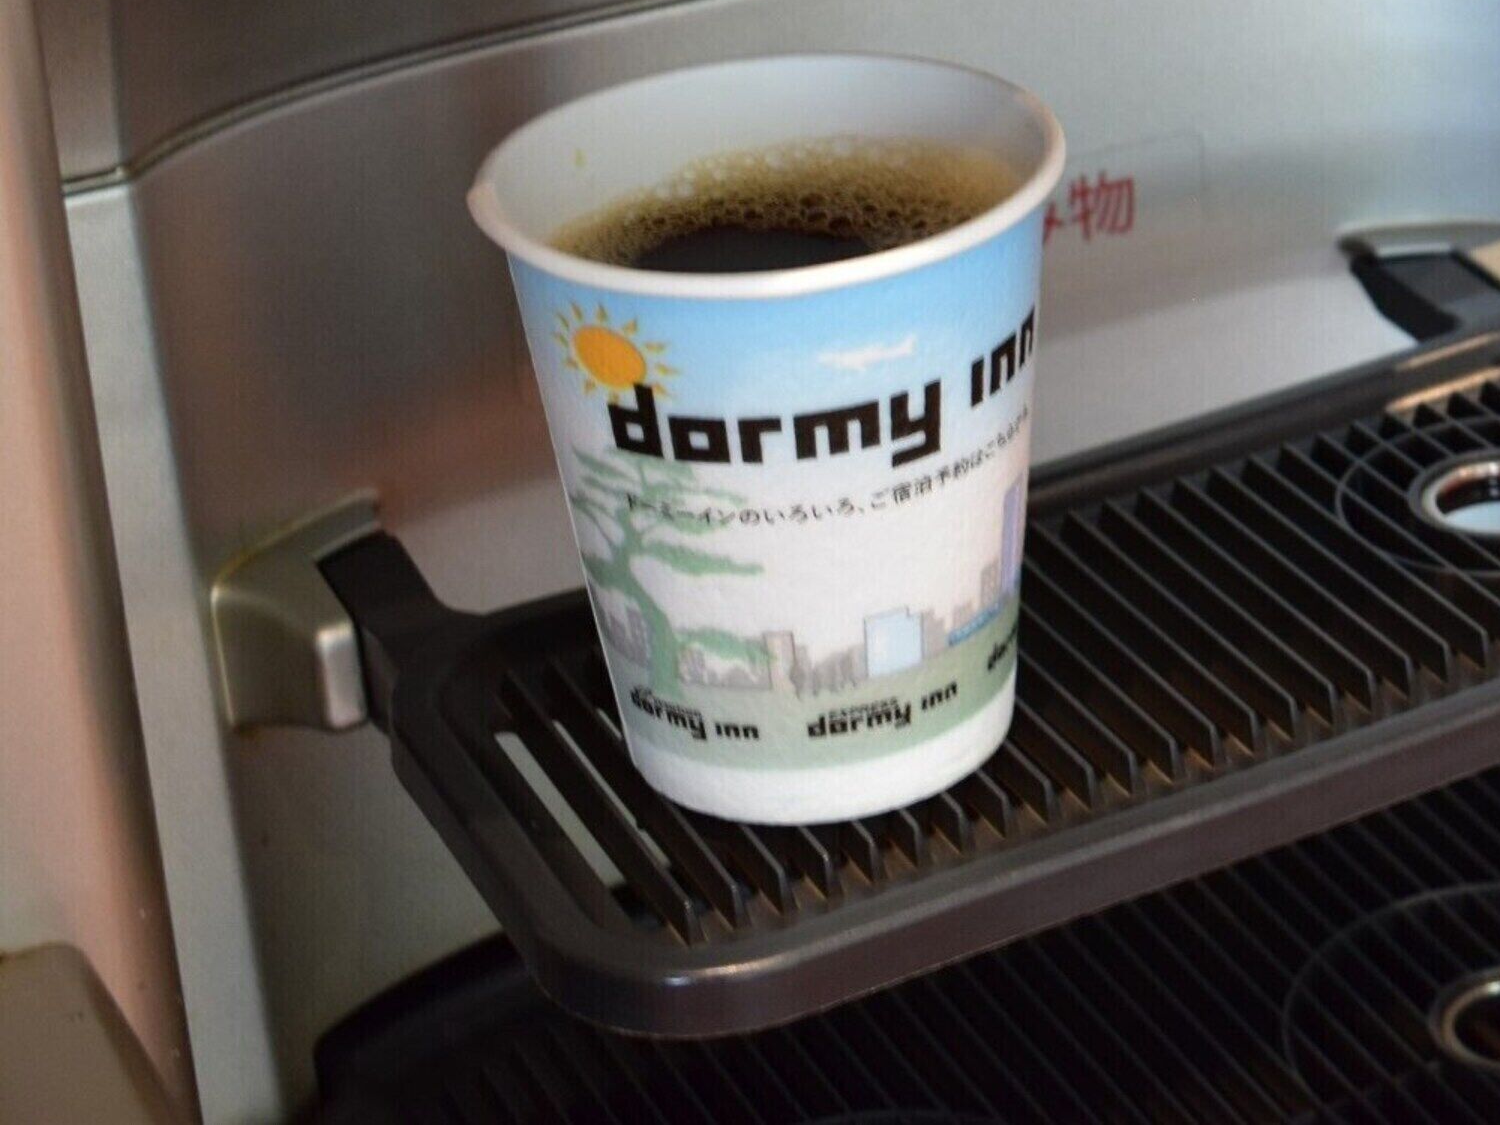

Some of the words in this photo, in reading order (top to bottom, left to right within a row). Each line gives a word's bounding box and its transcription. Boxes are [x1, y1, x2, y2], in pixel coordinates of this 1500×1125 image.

[608, 378, 942, 468] dormy
[970, 304, 1035, 408] inn
[630, 685, 707, 741] dormy
[715, 722, 760, 739] inn
[807, 702, 912, 738] dormy
[921, 680, 958, 711] inn
